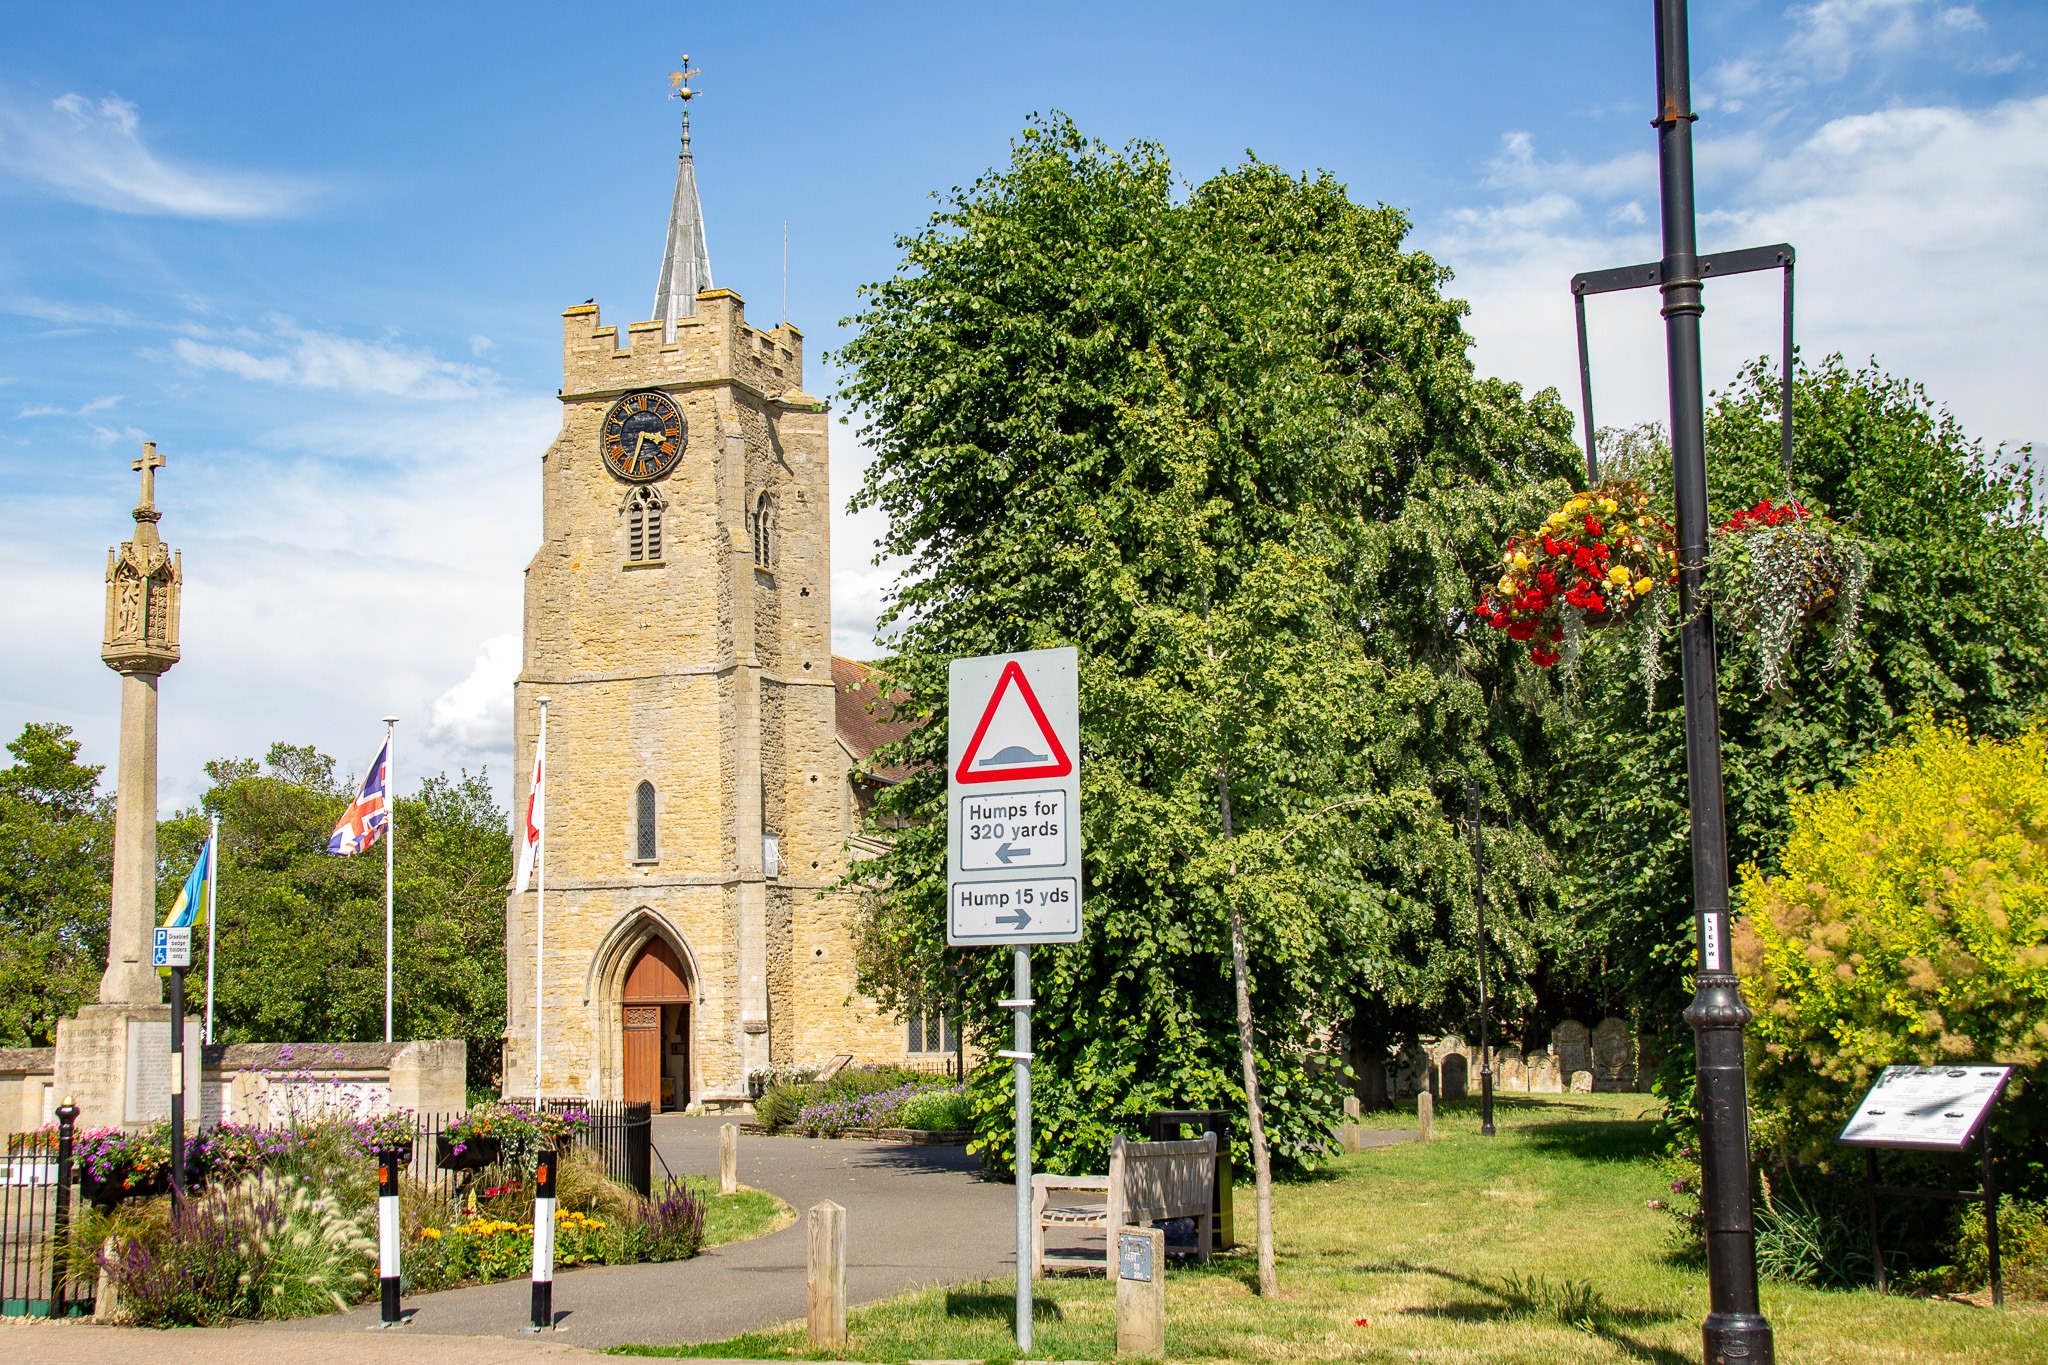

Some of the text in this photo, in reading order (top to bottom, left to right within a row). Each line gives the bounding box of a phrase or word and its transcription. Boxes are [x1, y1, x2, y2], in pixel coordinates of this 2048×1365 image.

[970, 801, 1058, 820] Humps for
[970, 821, 1058, 841] 320 yards
[961, 887, 1069, 907] Hump 15 yds
[157, 931, 166, 945] P
